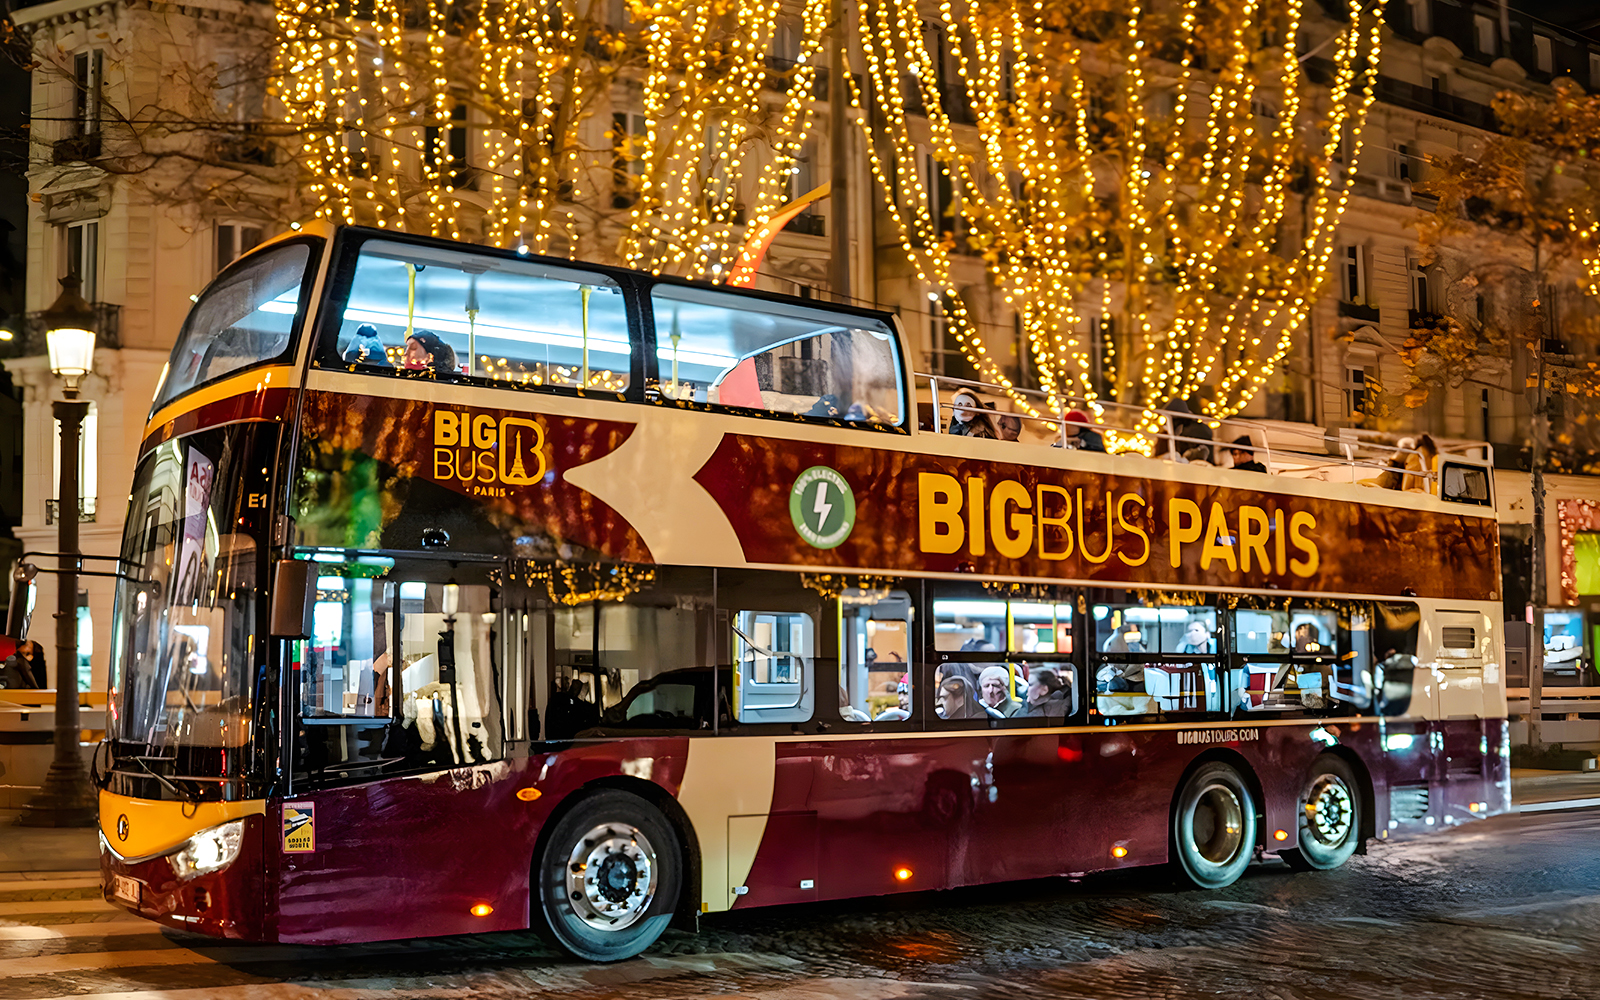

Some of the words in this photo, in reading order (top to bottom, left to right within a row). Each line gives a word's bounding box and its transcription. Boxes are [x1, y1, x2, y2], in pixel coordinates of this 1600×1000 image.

[434, 410, 497, 449] BIG
[434, 448, 497, 483] BUS
[248, 493, 267, 508] E1
[473, 486, 506, 497] PARIS
[1168, 497, 1320, 578] PARIS
